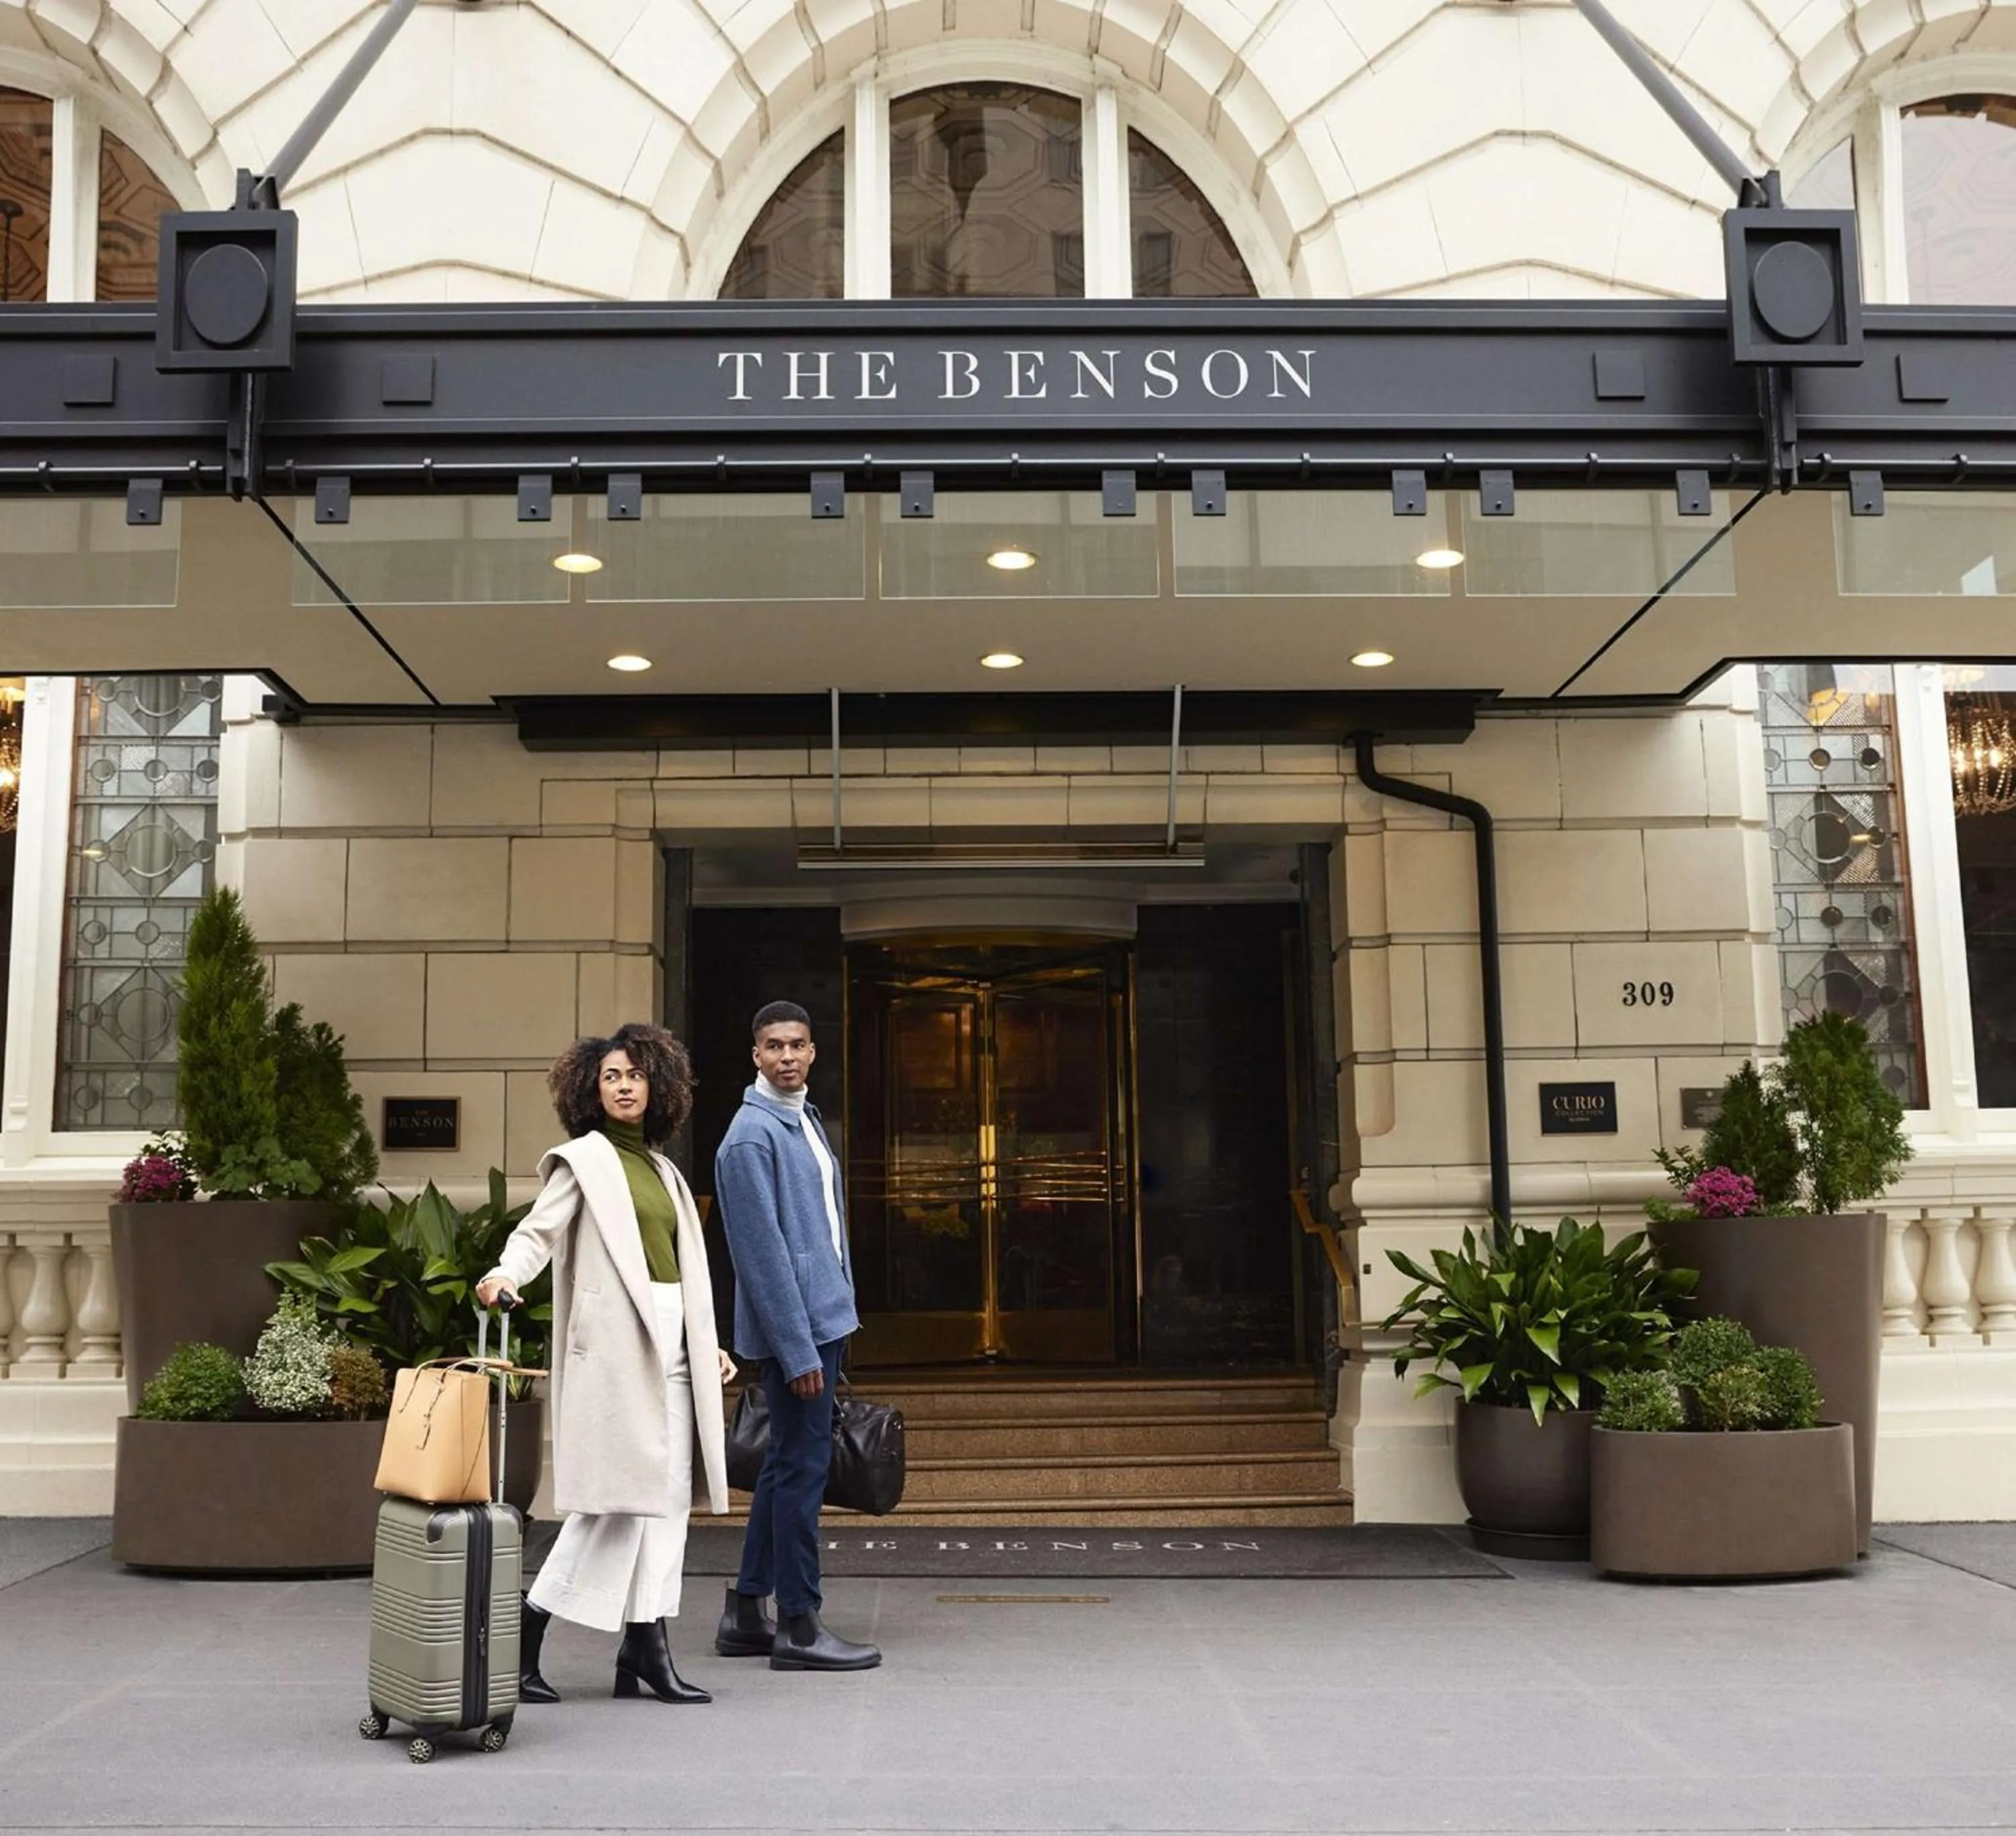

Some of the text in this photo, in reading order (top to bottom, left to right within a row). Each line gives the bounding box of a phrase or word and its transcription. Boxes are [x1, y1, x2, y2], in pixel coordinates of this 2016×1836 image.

[717, 348, 1318, 401] THE BENSON
[1622, 980, 1675, 1007] 309
[1552, 1096, 1605, 1110] CURIO
[936, 1540, 1261, 1551] BENSON
